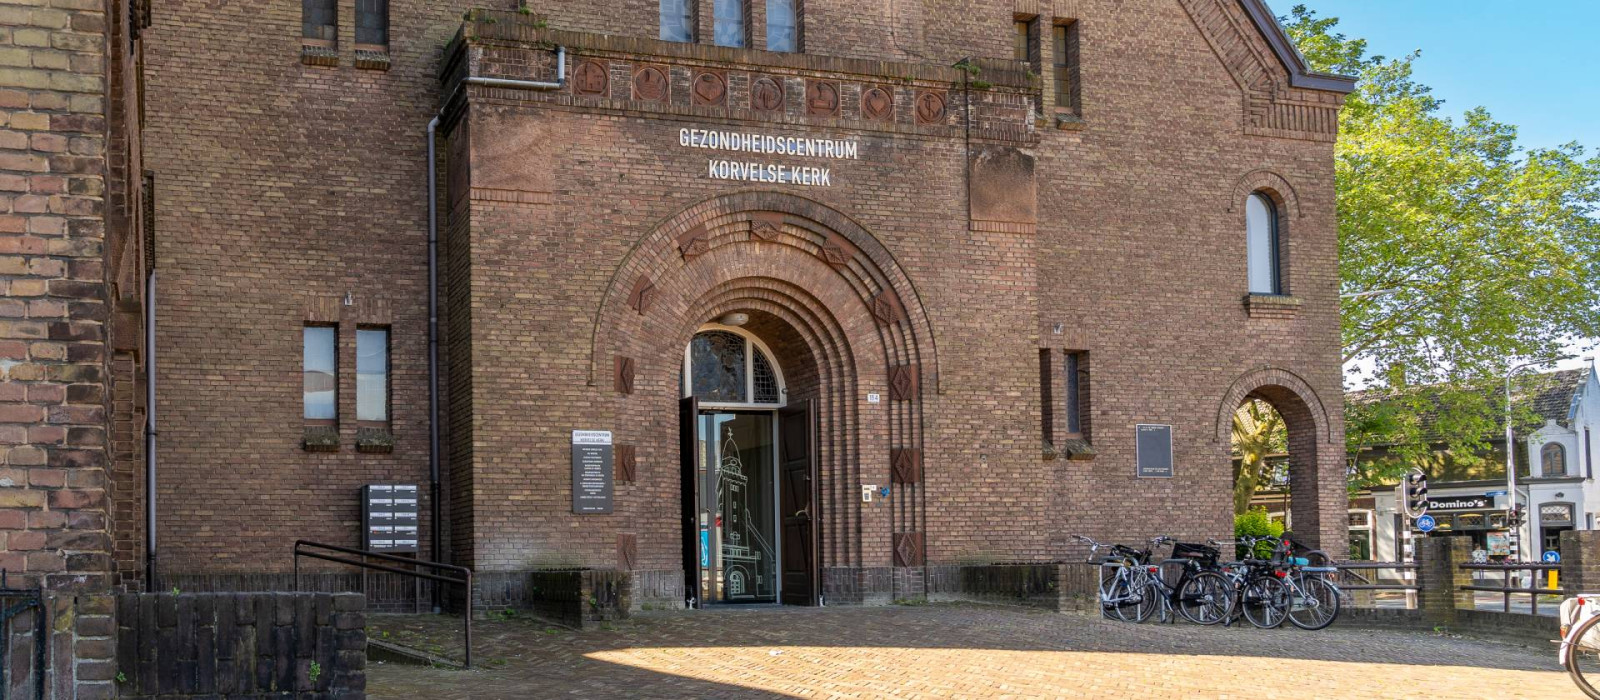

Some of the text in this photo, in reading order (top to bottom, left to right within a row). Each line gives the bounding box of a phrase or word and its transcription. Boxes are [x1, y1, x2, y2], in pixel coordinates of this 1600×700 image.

[679, 128, 858, 159] GEZONDHEIDSCENTRUM
[708, 159, 831, 187] KORVELSE KERK
[1430, 500, 1485, 509] Domino's
